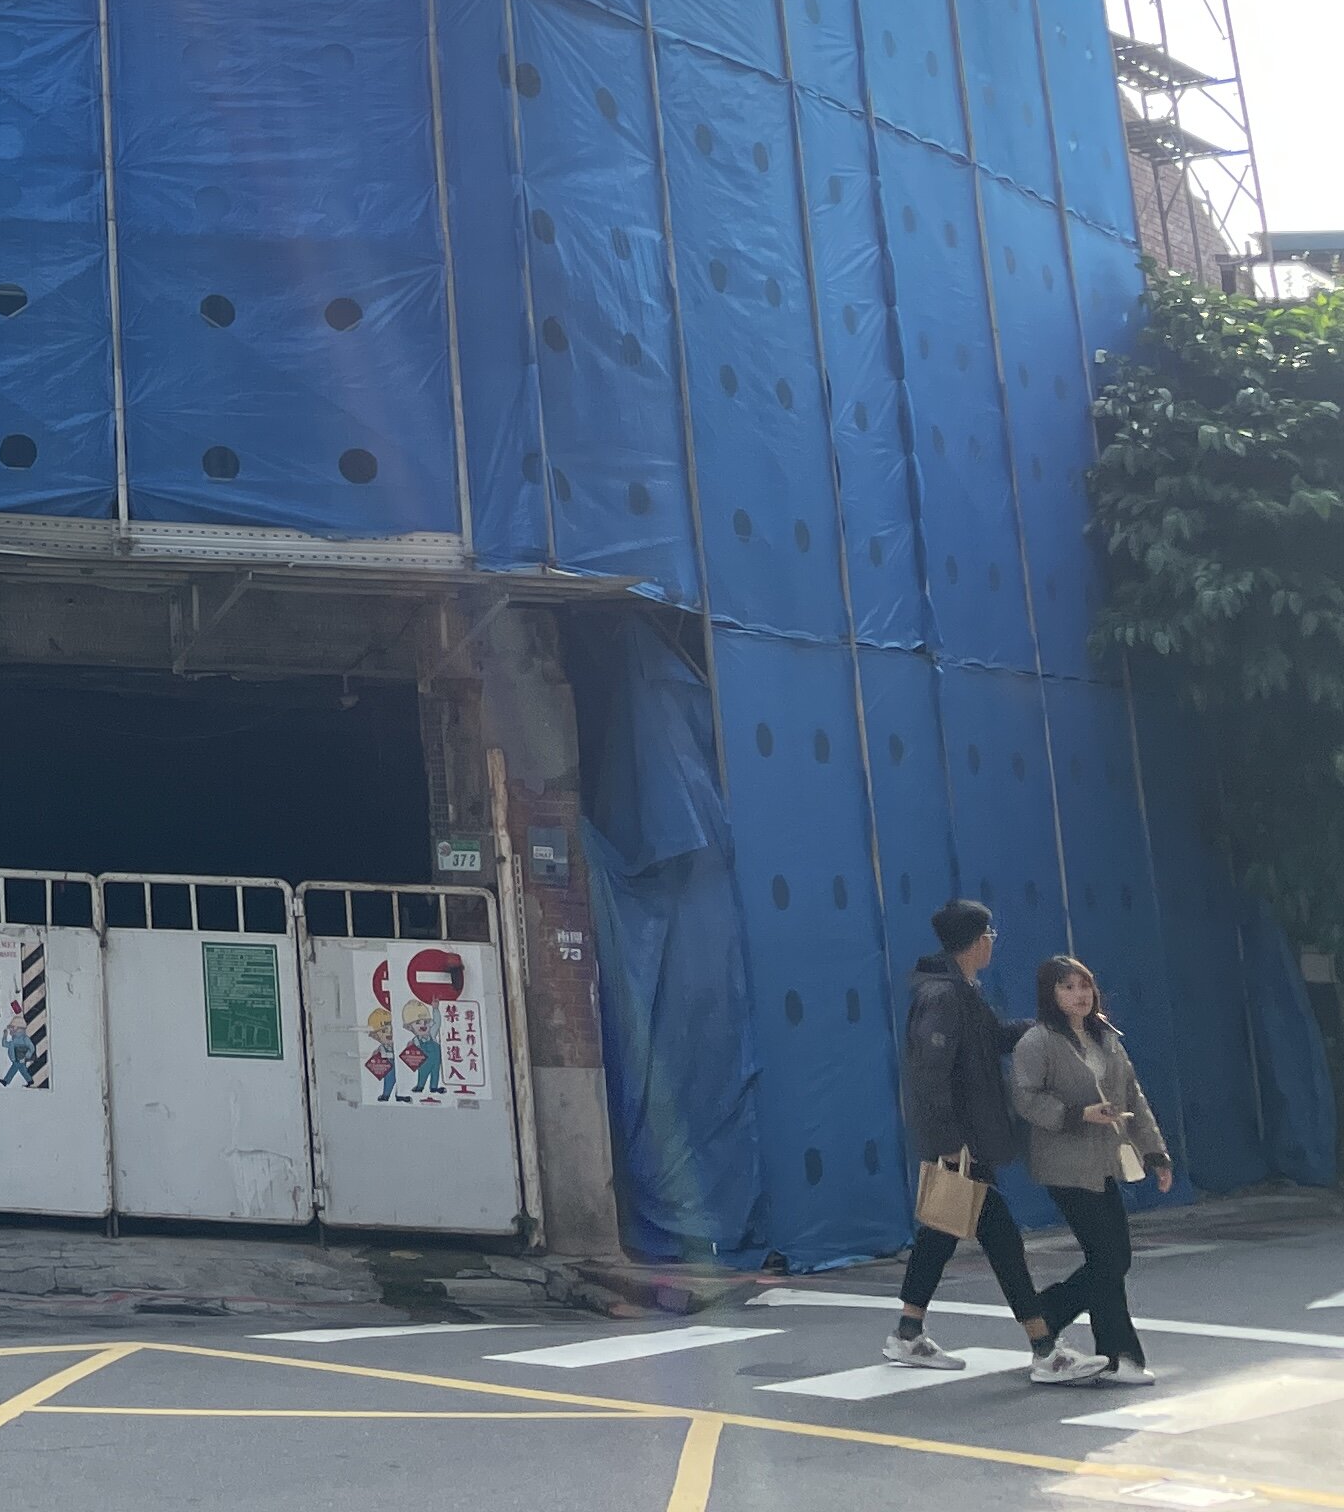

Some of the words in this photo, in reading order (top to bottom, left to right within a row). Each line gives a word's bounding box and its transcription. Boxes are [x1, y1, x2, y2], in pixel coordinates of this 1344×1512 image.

[452, 853, 476, 867] 372
[559, 947, 582, 961] 73
[444, 1004, 466, 1081] 禁止進入
[464, 1009, 479, 1073] 非工作人員
